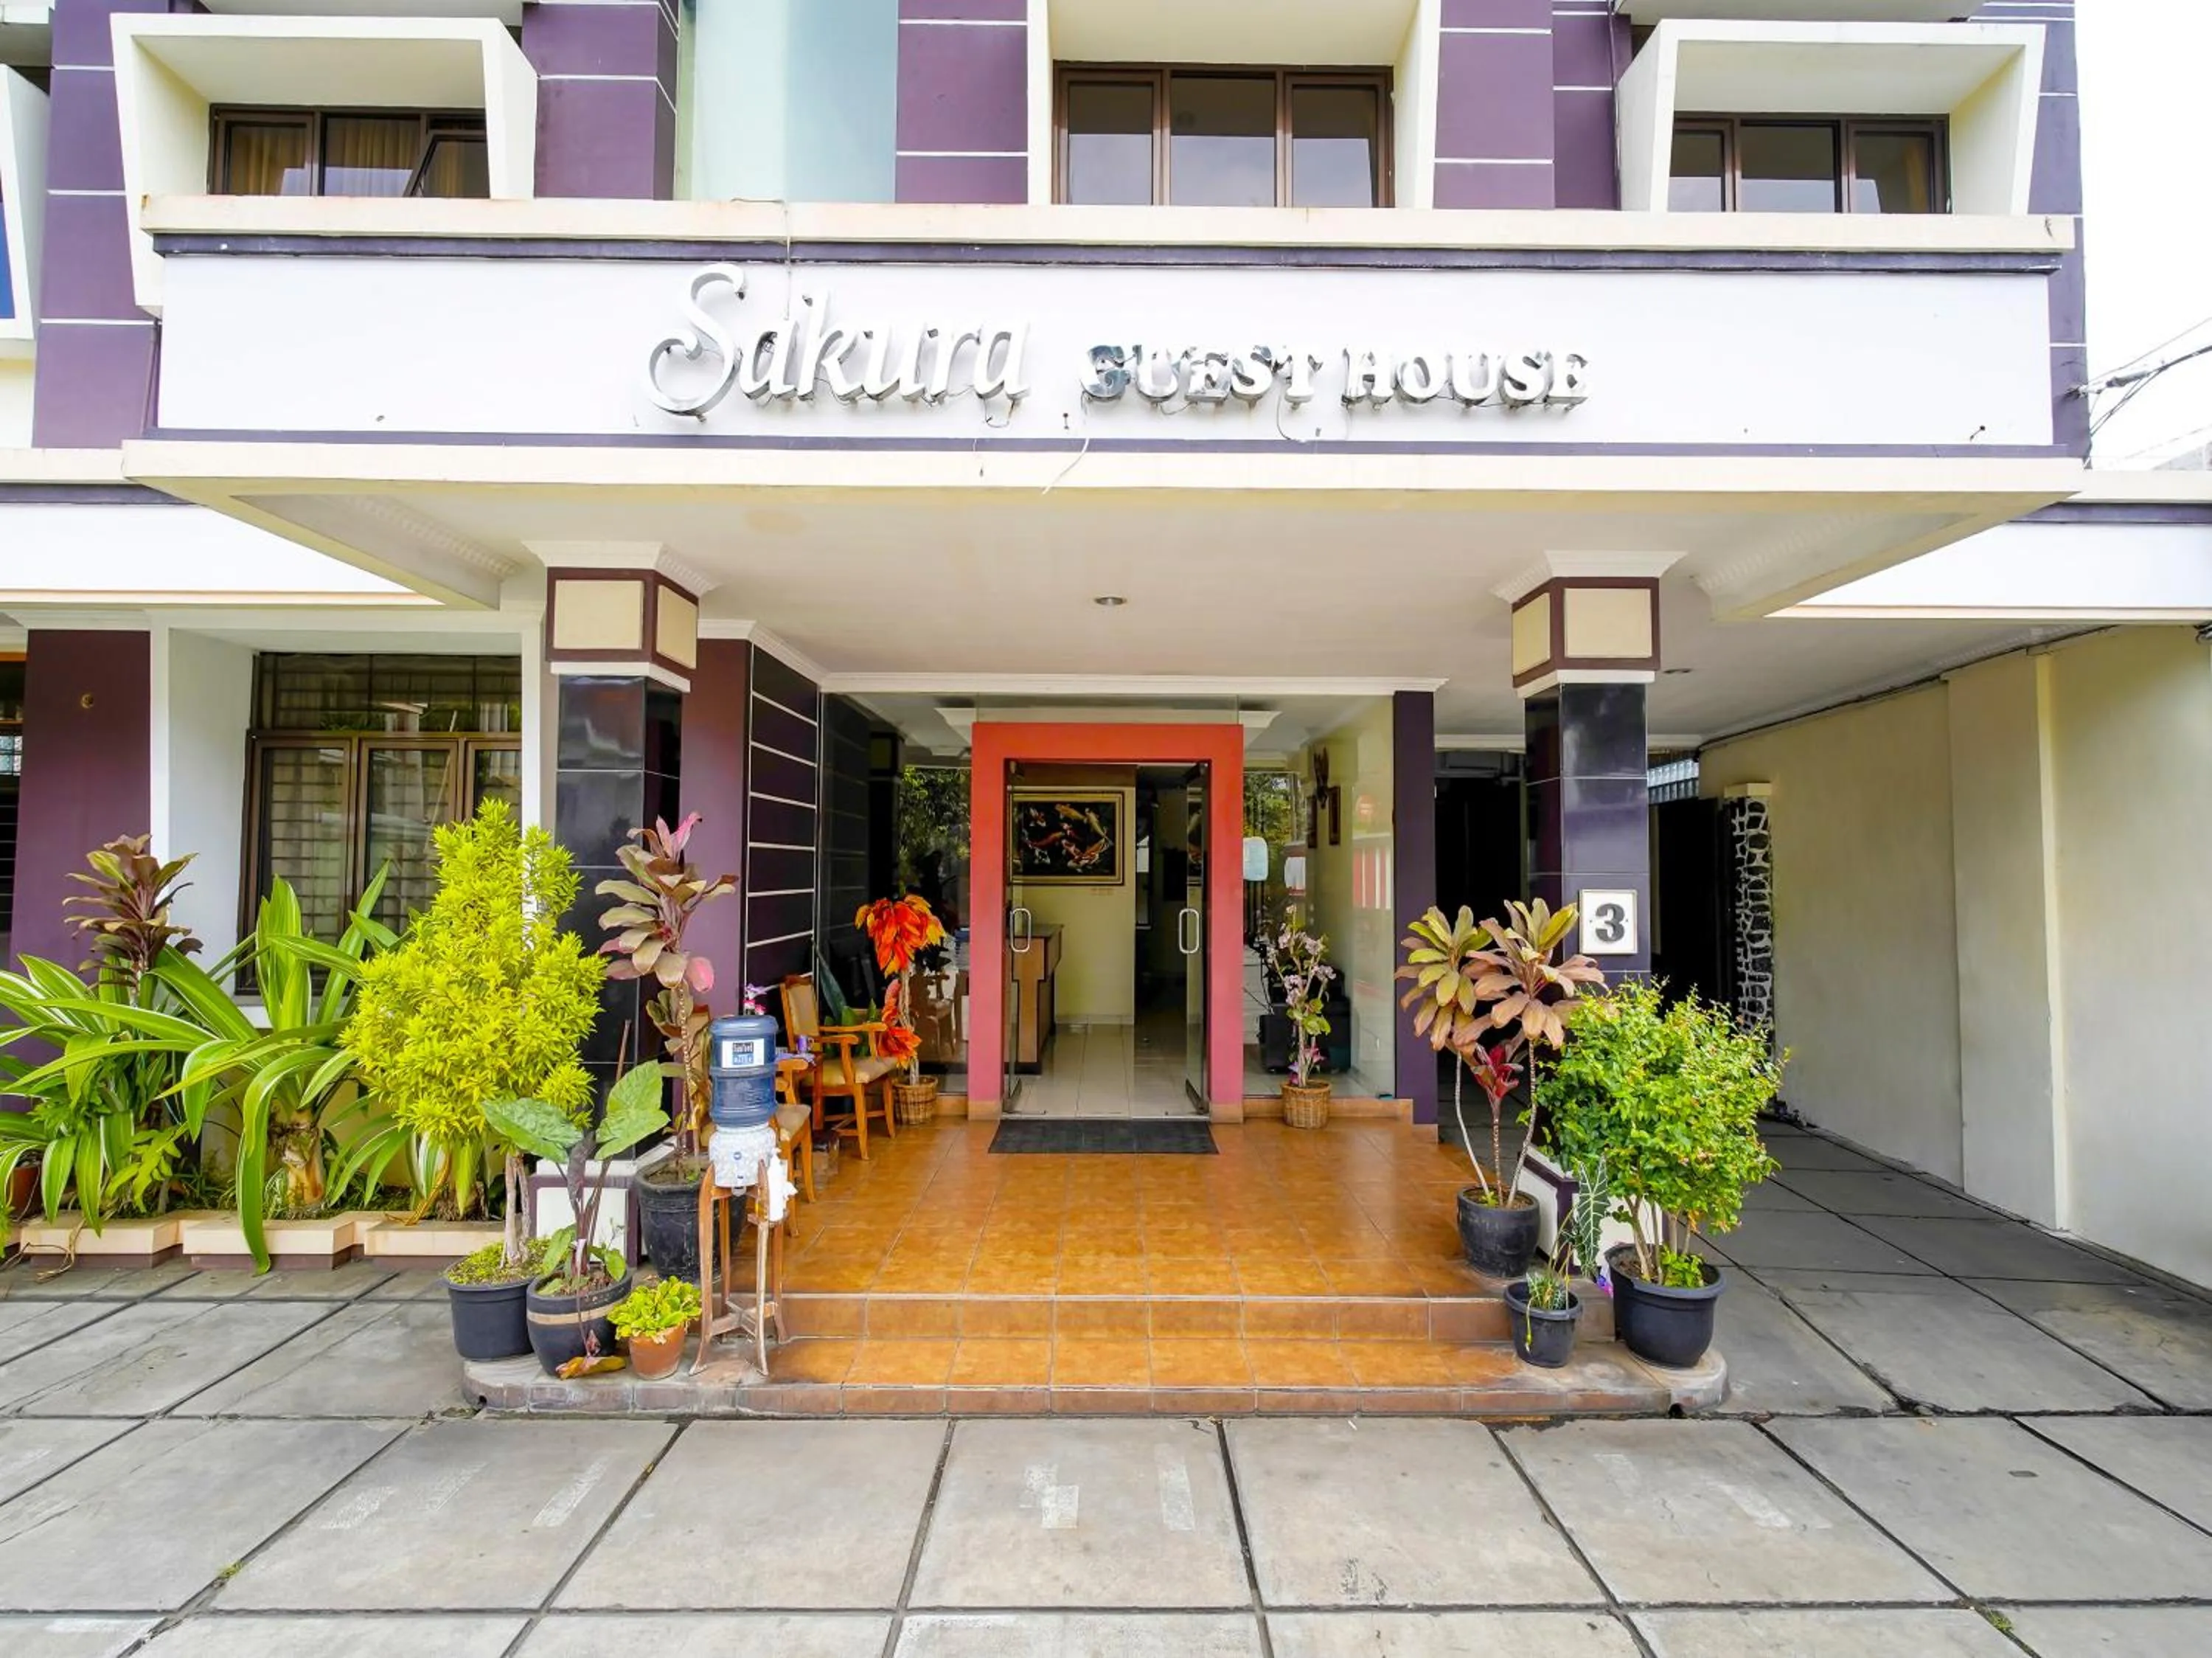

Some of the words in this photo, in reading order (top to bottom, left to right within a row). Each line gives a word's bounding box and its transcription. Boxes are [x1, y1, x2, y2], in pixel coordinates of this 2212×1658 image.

[647, 263, 1032, 417] Sakura
[1079, 344, 1323, 403] GUEST
[1340, 344, 1591, 406] HOUSE
[1595, 903, 1625, 942] 3
